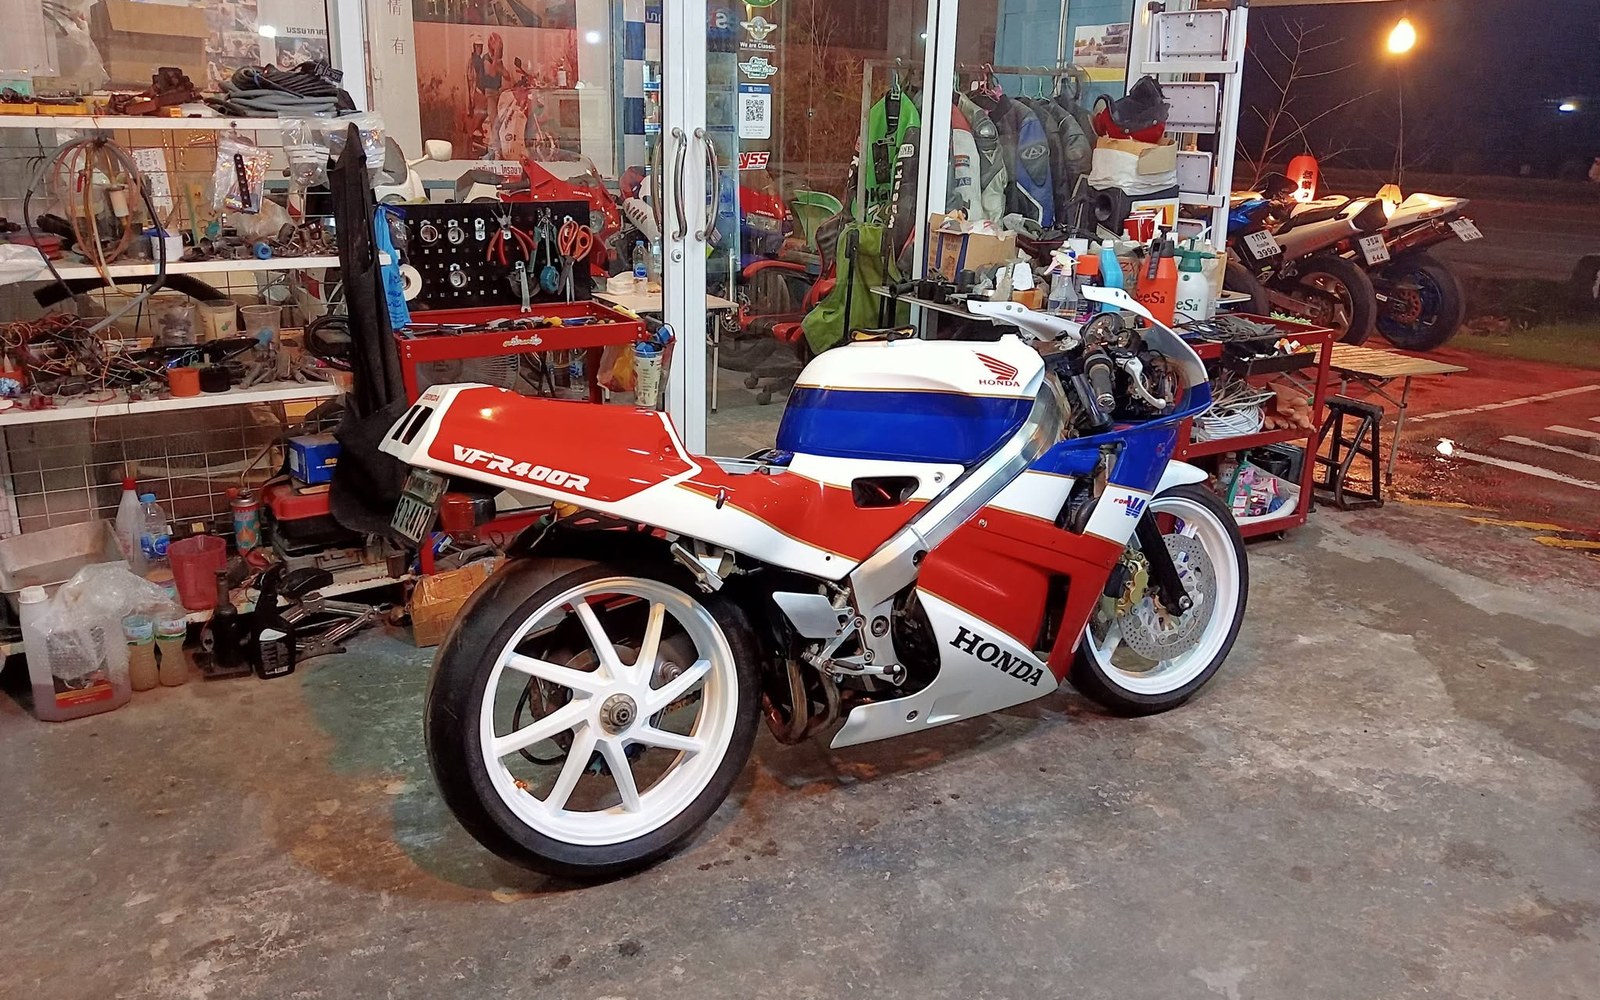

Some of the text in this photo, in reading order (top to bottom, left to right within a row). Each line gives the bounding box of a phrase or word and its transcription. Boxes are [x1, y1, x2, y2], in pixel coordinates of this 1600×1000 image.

[1256, 245, 1278, 258] 3999
[978, 379, 1021, 388] HONDA
[453, 443, 591, 493] VFR400R
[948, 625, 1045, 687] HONDA
